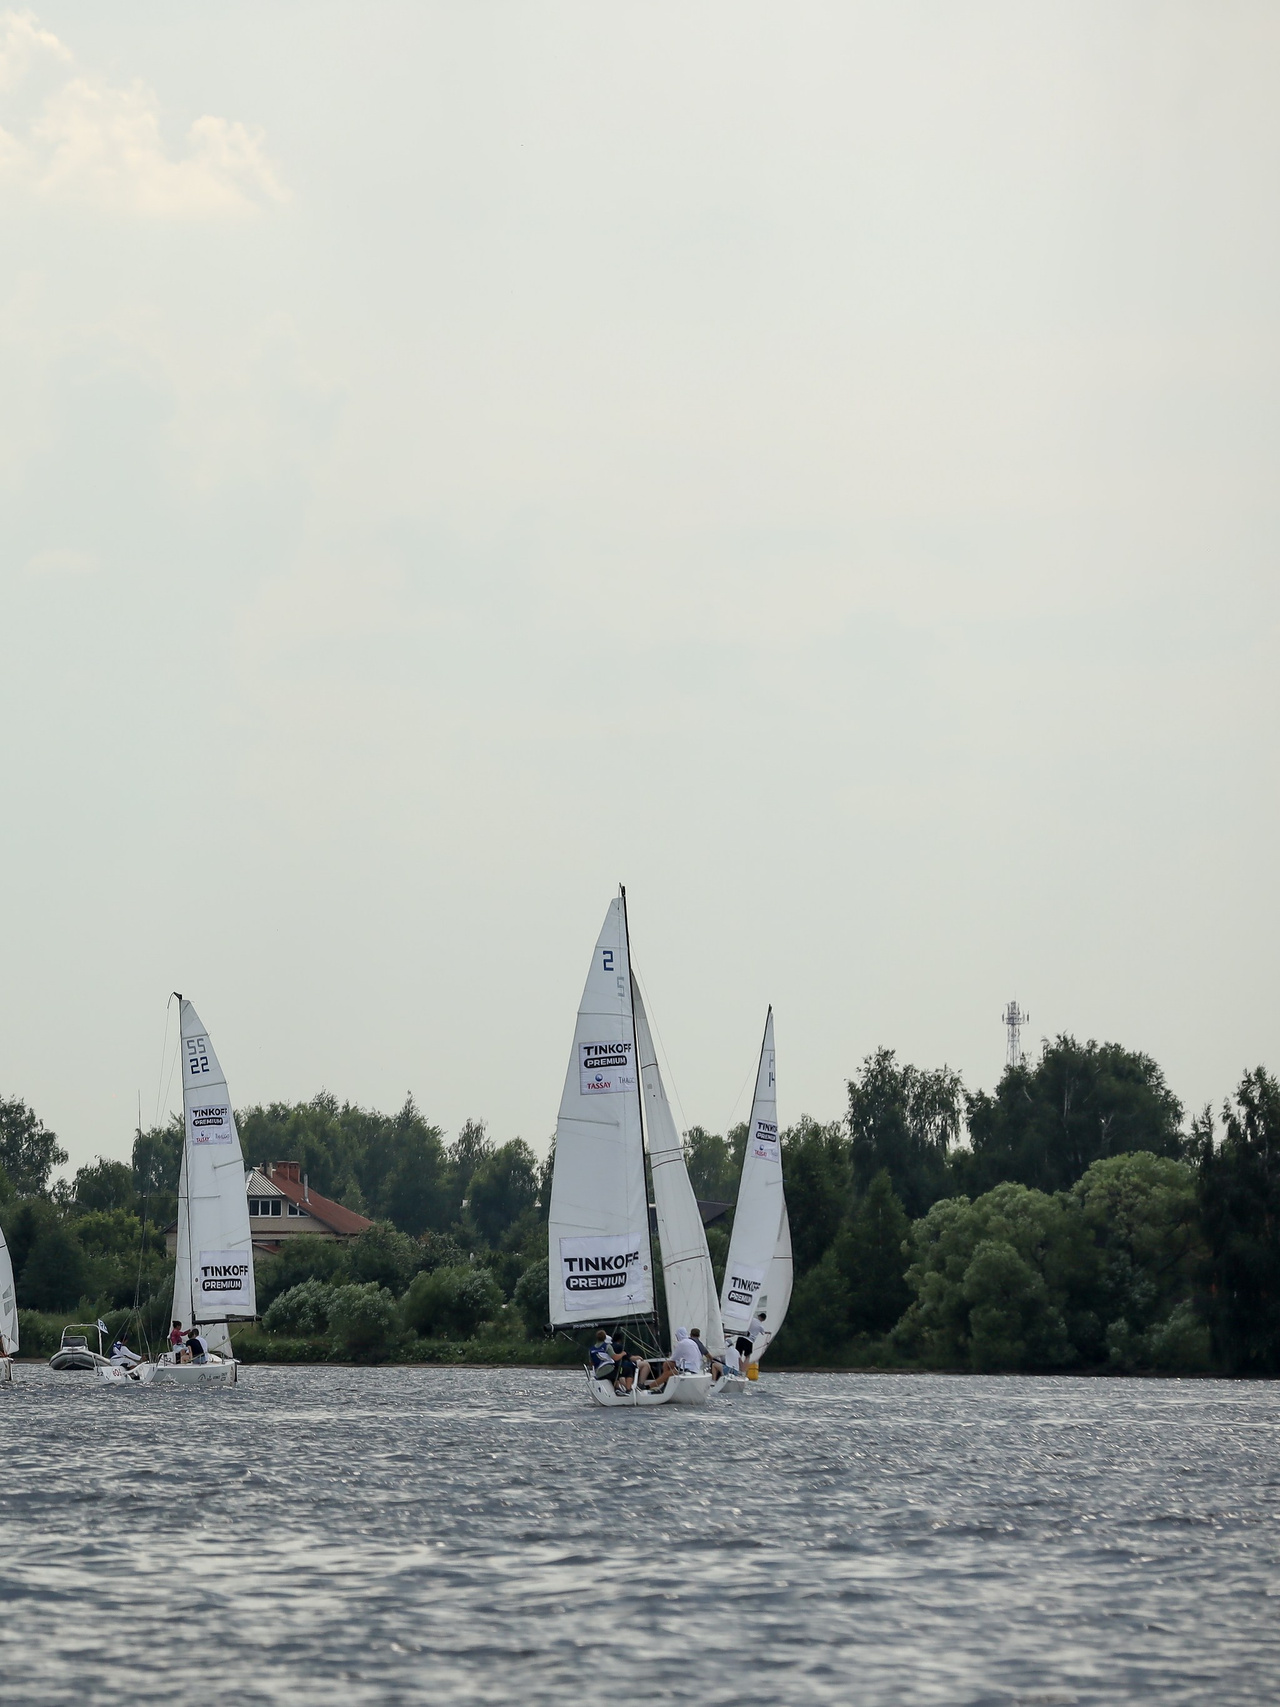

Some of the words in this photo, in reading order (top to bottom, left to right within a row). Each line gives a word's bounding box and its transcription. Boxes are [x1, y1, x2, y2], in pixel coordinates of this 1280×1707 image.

[603, 950, 614, 971] 2
[583, 1043, 631, 1056] TINKOFF
[190, 1056, 209, 1074] 22
[587, 1057, 626, 1067] PREMIUM
[587, 1082, 611, 1090] TASSAY
[193, 1108, 227, 1117] TINKOFF
[564, 1251, 639, 1272] TINKOFF
[201, 1265, 248, 1277] TINKOFF
[204, 1280, 241, 1290] PREMIUM
[570, 1274, 625, 1289] PREMIUM
